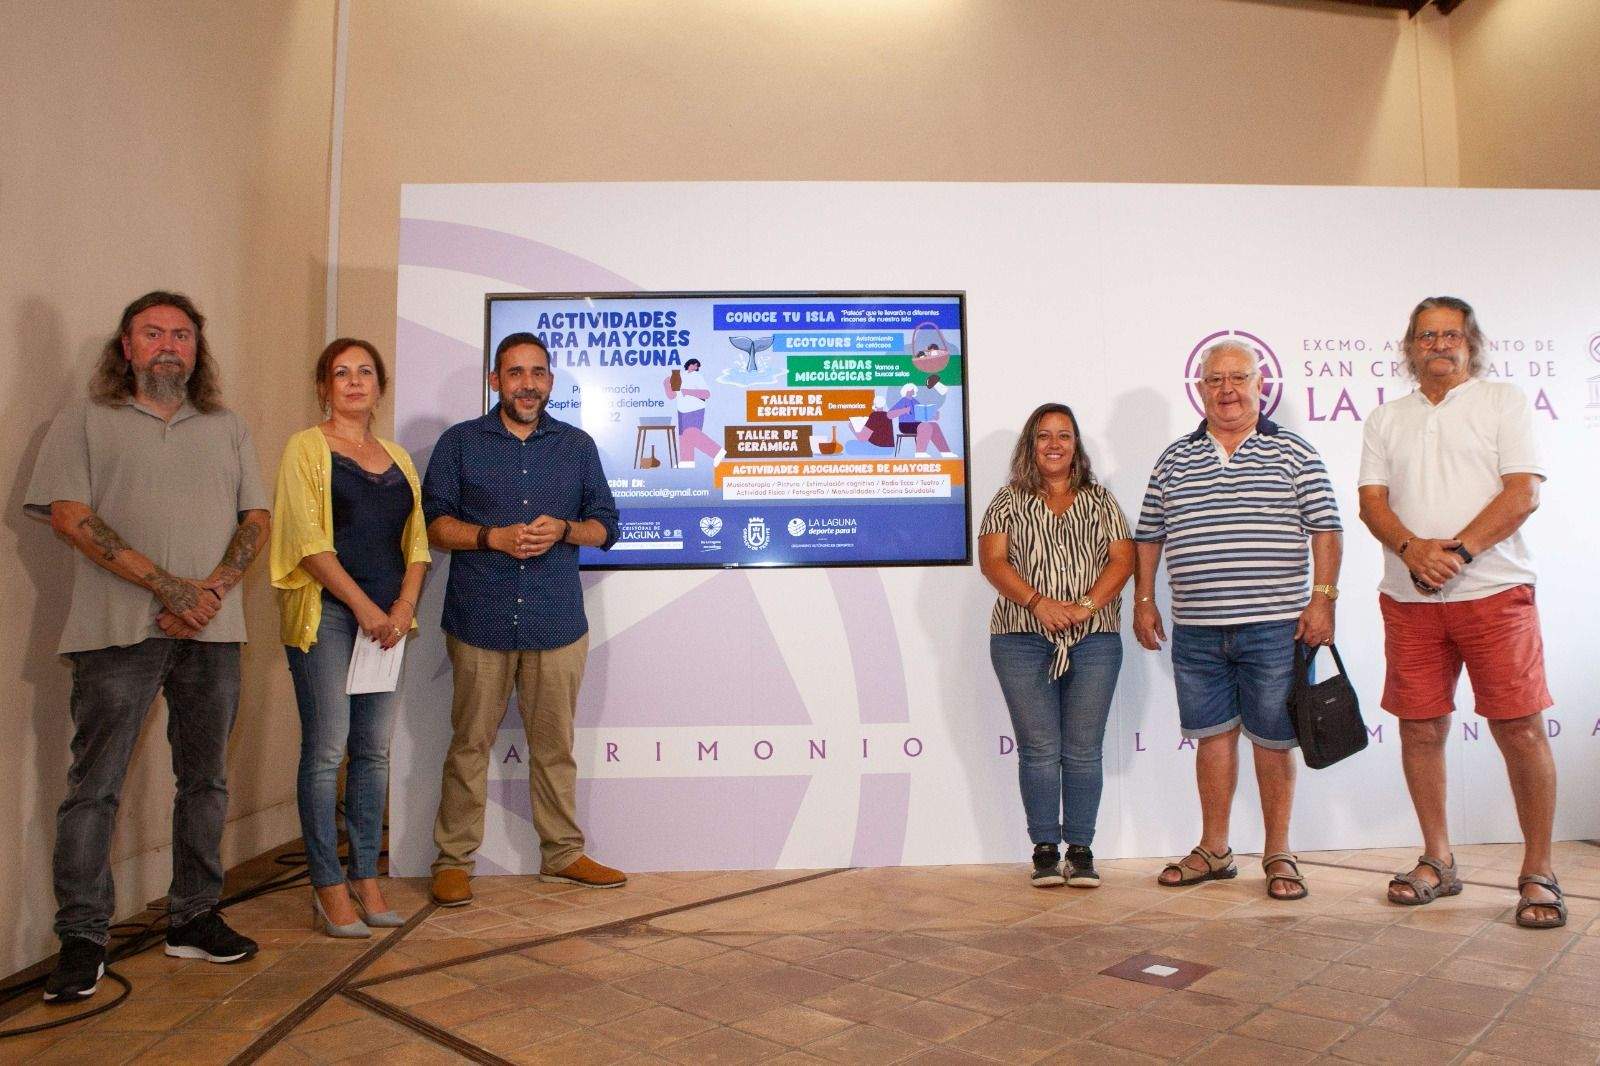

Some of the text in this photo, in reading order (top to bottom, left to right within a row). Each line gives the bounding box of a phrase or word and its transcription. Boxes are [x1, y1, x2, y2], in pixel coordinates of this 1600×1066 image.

[537, 311, 677, 329] ACTIVIDADES
[725, 311, 835, 323] CONOCE TU ISLA
[538, 330, 690, 349] ARA MAYORES
[786, 337, 851, 348] ECOTOURS
[1303, 339, 1373, 351] EXCMO.
[1535, 340, 1555, 351] DE
[566, 350, 590, 368] LA
[600, 349, 681, 367] LAGUNA
[823, 360, 872, 370] SALIDAS
[1304, 361, 1353, 377] SAN
[1528, 361, 1556, 377] DE
[795, 370, 872, 381] MICOLÓGICAS
[617, 398, 665, 408] diciembre
[761, 394, 823, 405] TALLER DE
[1306, 387, 1362, 421] LA
[757, 405, 823, 417] ESCRITURA
[736, 429, 798, 441] TALLER DE
[737, 440, 798, 452] CERÁMICA
[733, 463, 942, 475] ACTIVIDADES ASOCIACIONES DE MAYORES
[808, 518, 857, 526] LA LAGUNA
[622, 531, 660, 539] LAGUNA
[502, 737, 924, 764] ARIMONIO
